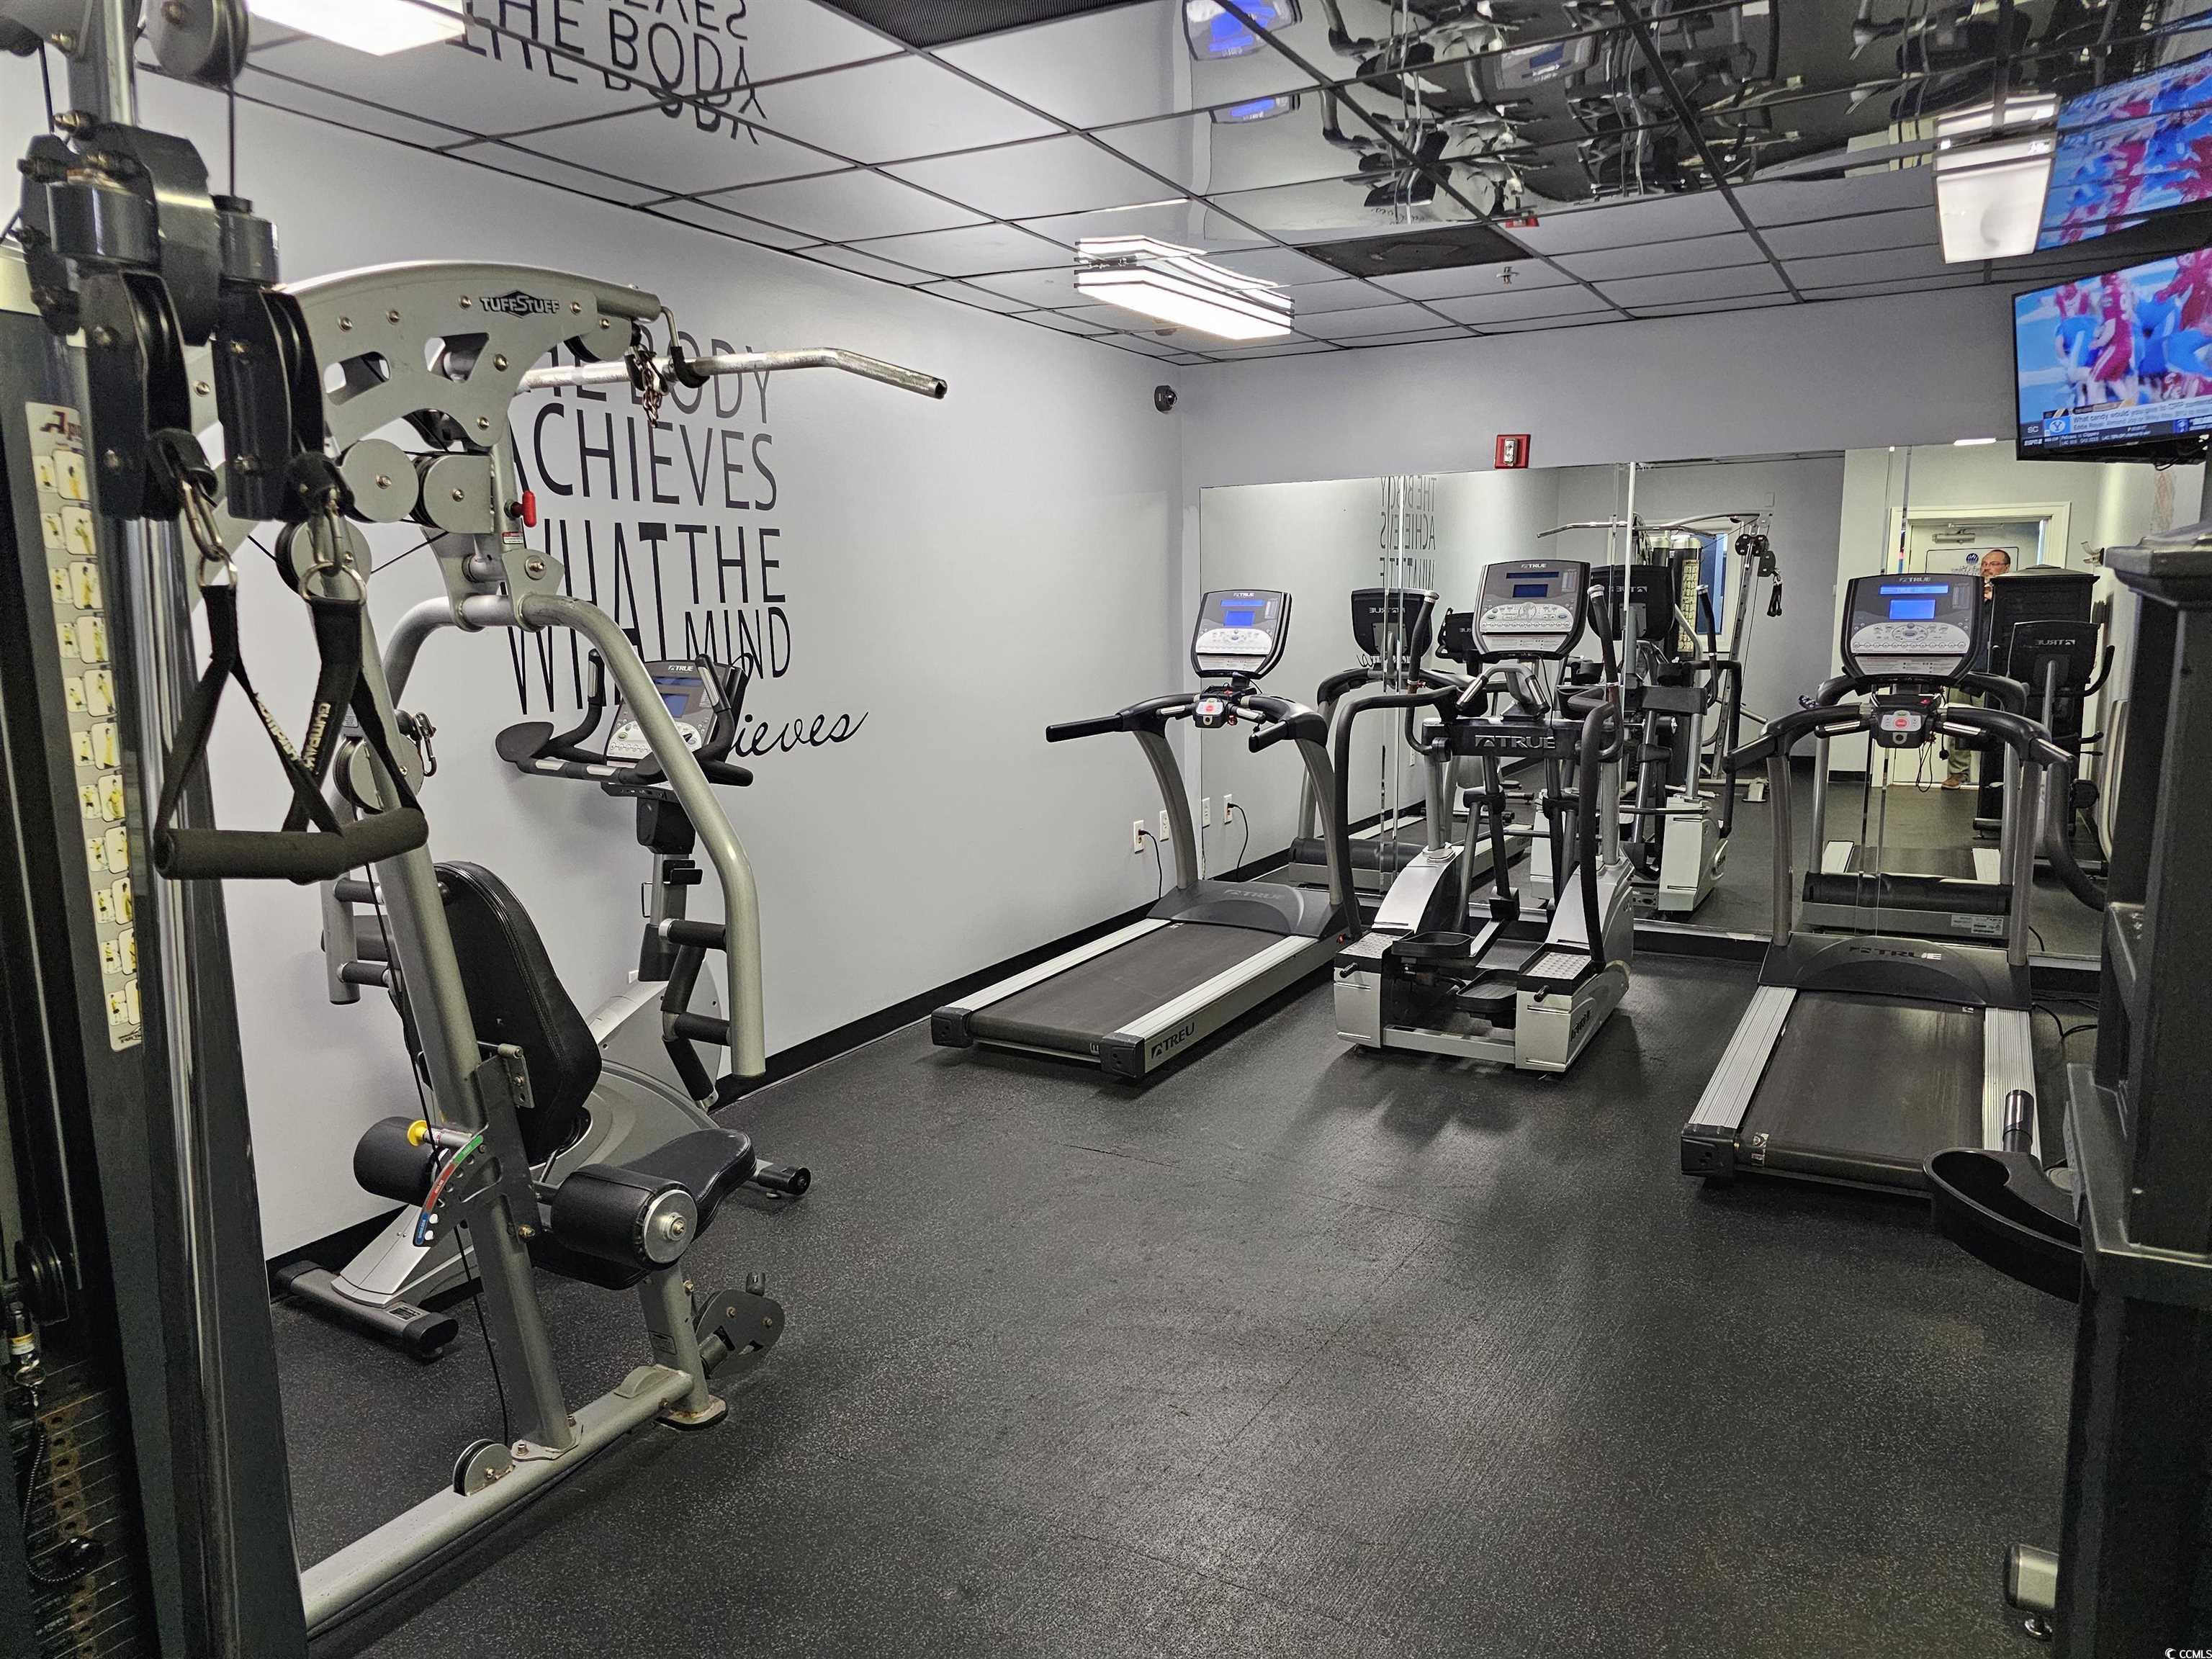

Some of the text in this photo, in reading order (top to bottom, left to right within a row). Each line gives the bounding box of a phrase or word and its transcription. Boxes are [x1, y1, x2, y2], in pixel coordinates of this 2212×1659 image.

[480, 295, 559, 314] TUFFSTUFF
[675, 523, 786, 605] THE
[685, 606, 791, 680] MIND
[1495, 735, 1556, 749] TRUE
